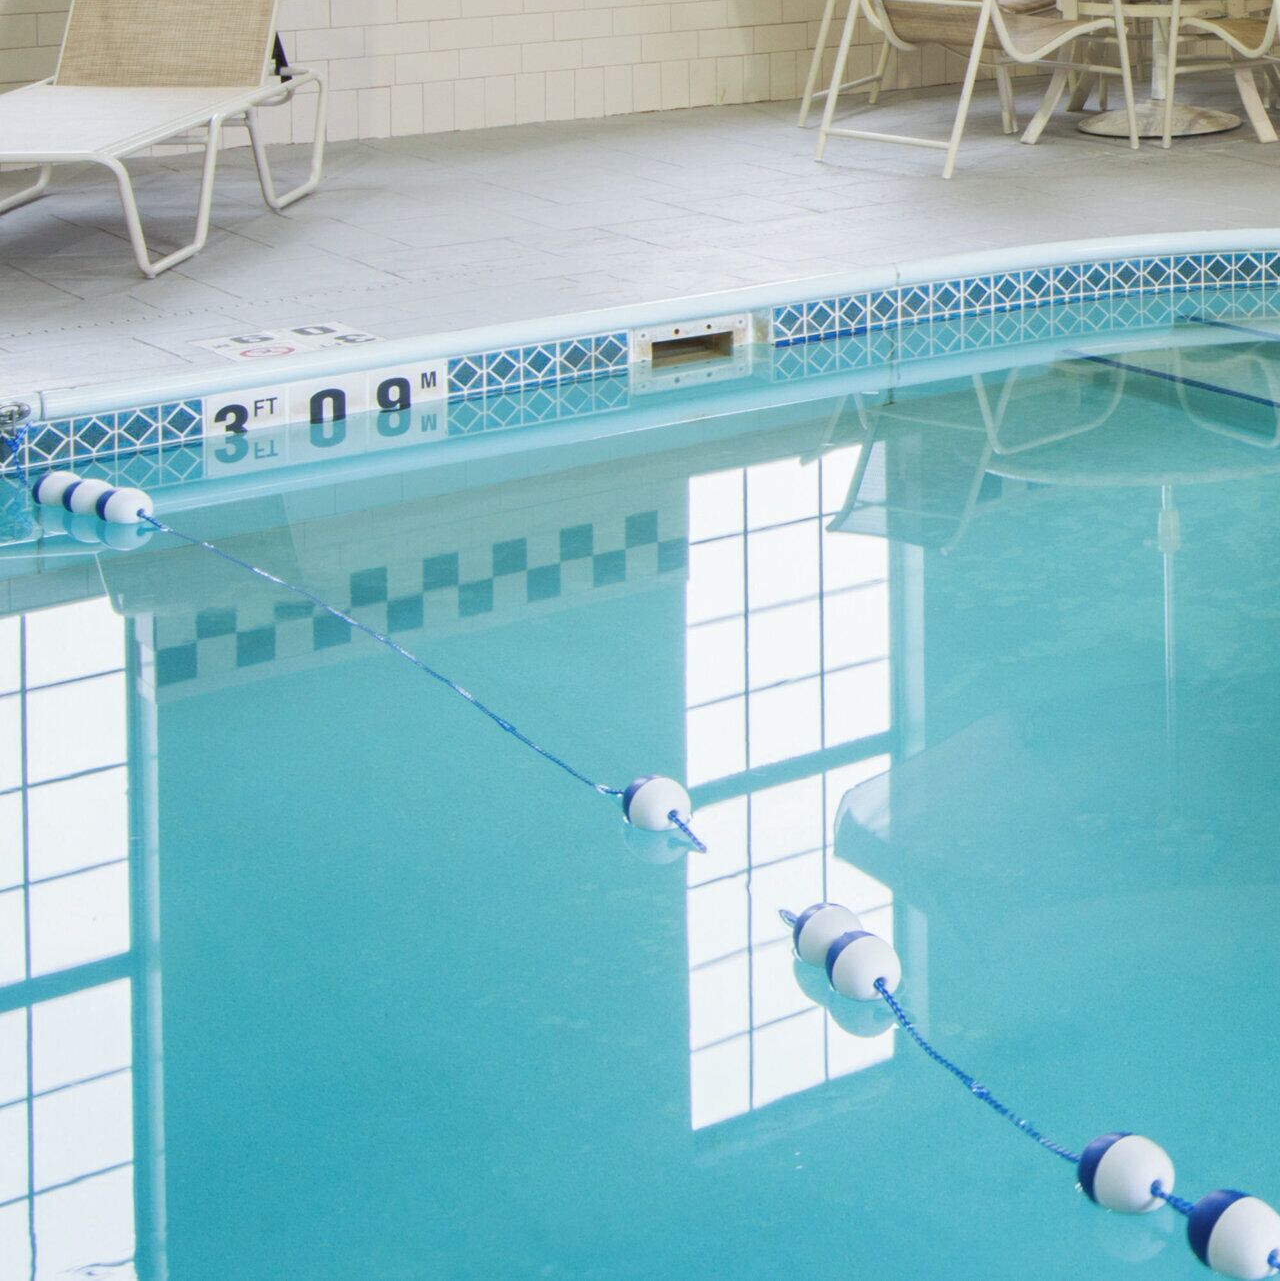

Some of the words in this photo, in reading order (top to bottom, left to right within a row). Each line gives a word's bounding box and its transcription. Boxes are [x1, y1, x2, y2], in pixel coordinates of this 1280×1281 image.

[214, 404, 249, 434] 3
[253, 397, 278, 418] FT
[421, 371, 437, 389] M
